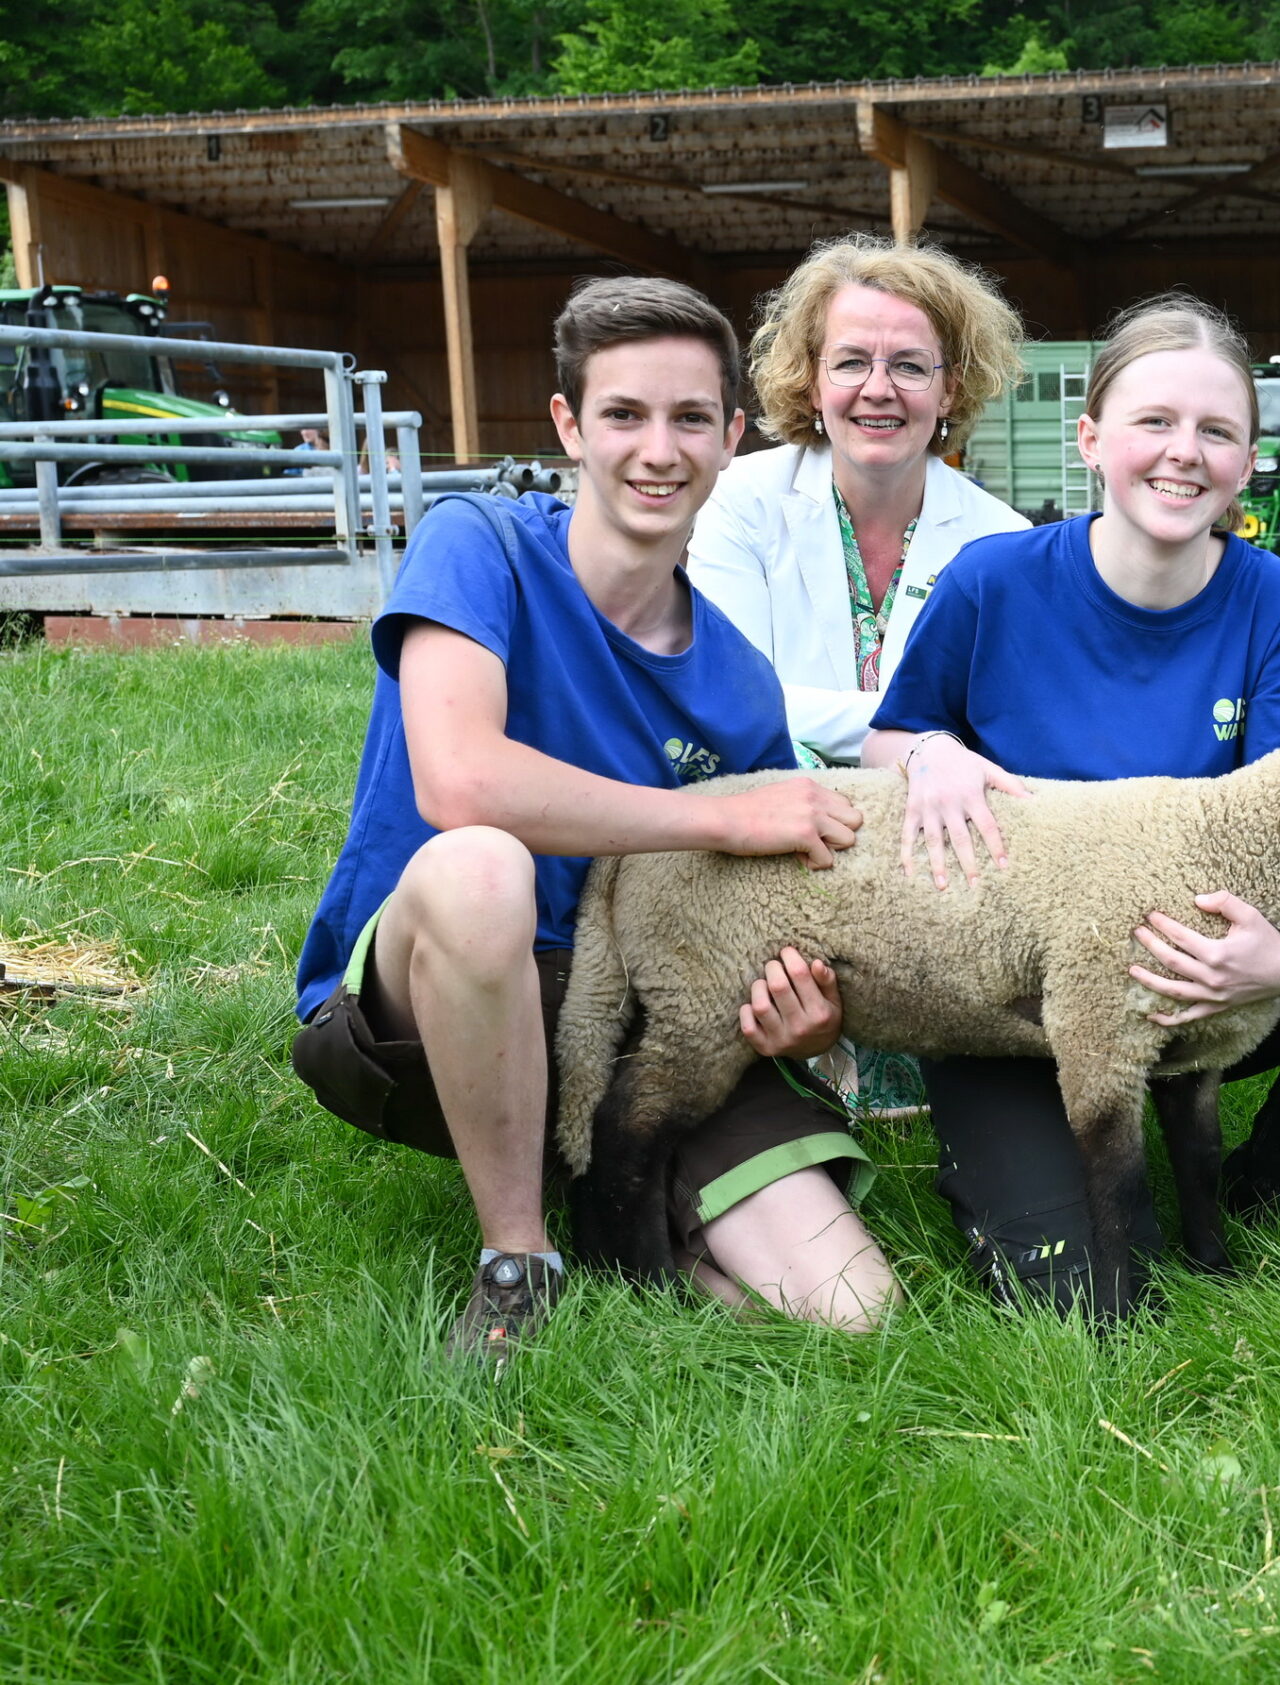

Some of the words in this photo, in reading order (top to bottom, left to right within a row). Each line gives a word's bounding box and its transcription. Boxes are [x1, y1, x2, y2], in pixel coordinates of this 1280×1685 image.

[1084, 96, 1099, 121] 3
[655, 117, 666, 139] 2
[679, 742, 721, 774] LFS
